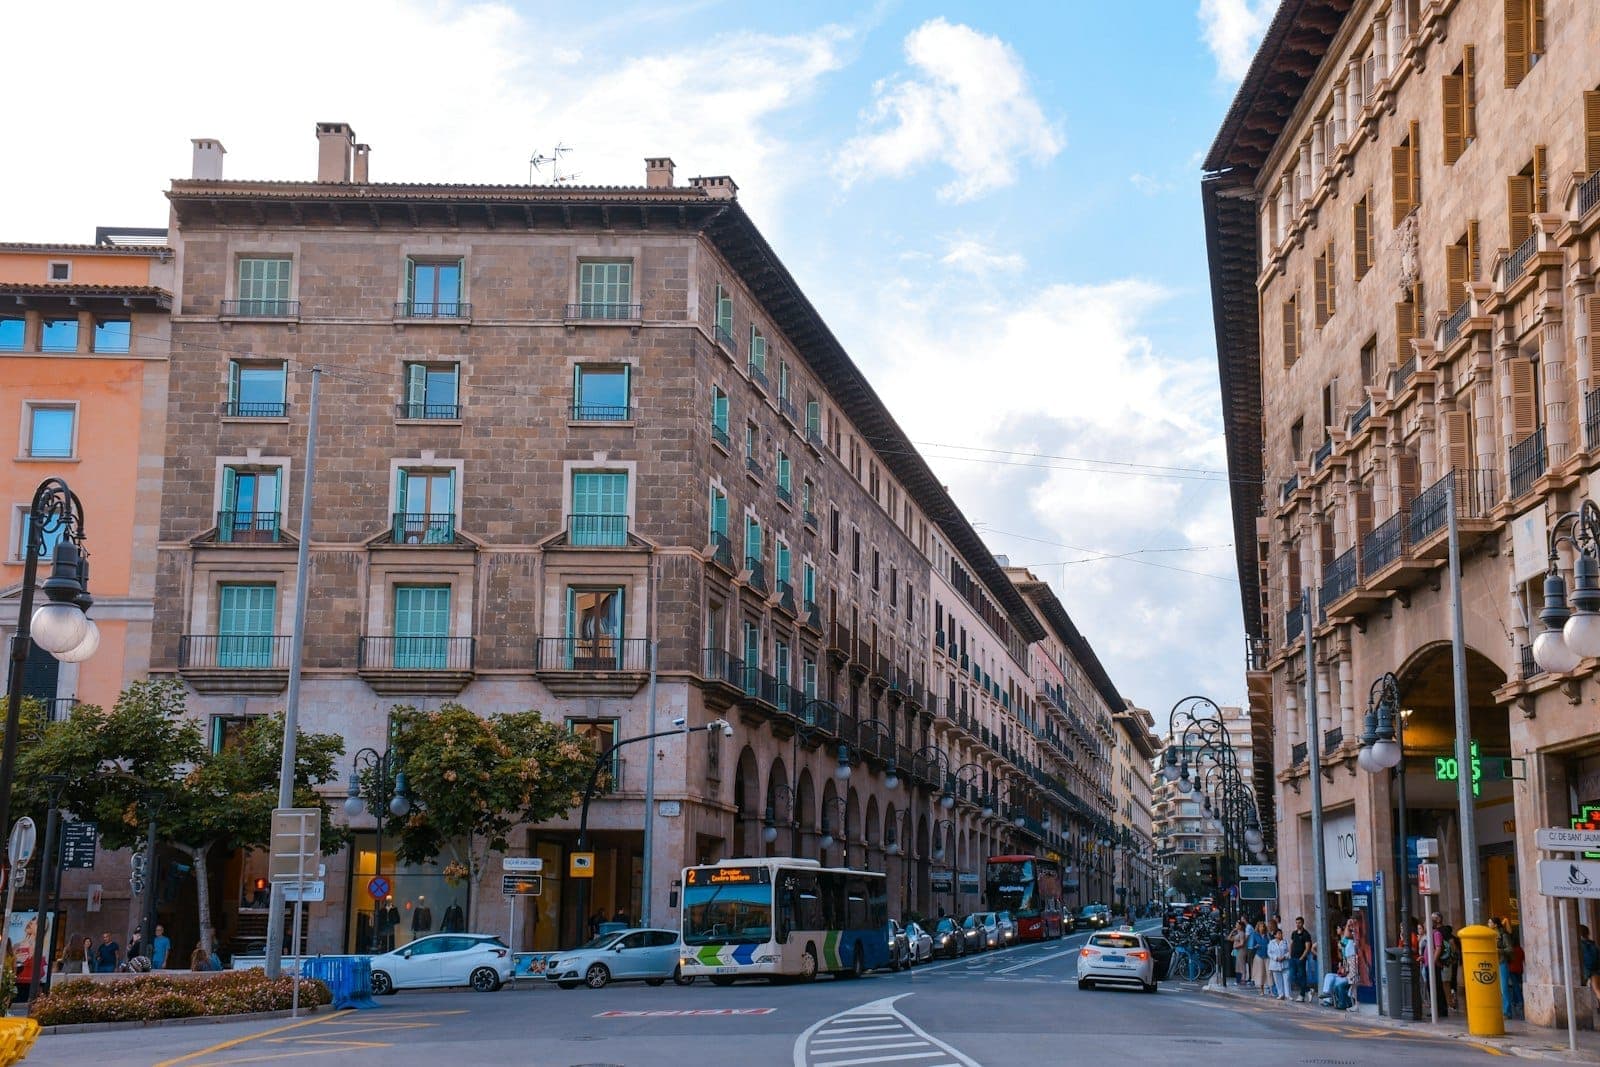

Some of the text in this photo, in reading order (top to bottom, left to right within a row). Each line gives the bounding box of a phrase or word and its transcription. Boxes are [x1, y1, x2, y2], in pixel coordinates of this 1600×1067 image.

[1558, 833, 1567, 841] DE
[1568, 833, 1582, 841] SANT
[688, 870, 696, 883] 2
